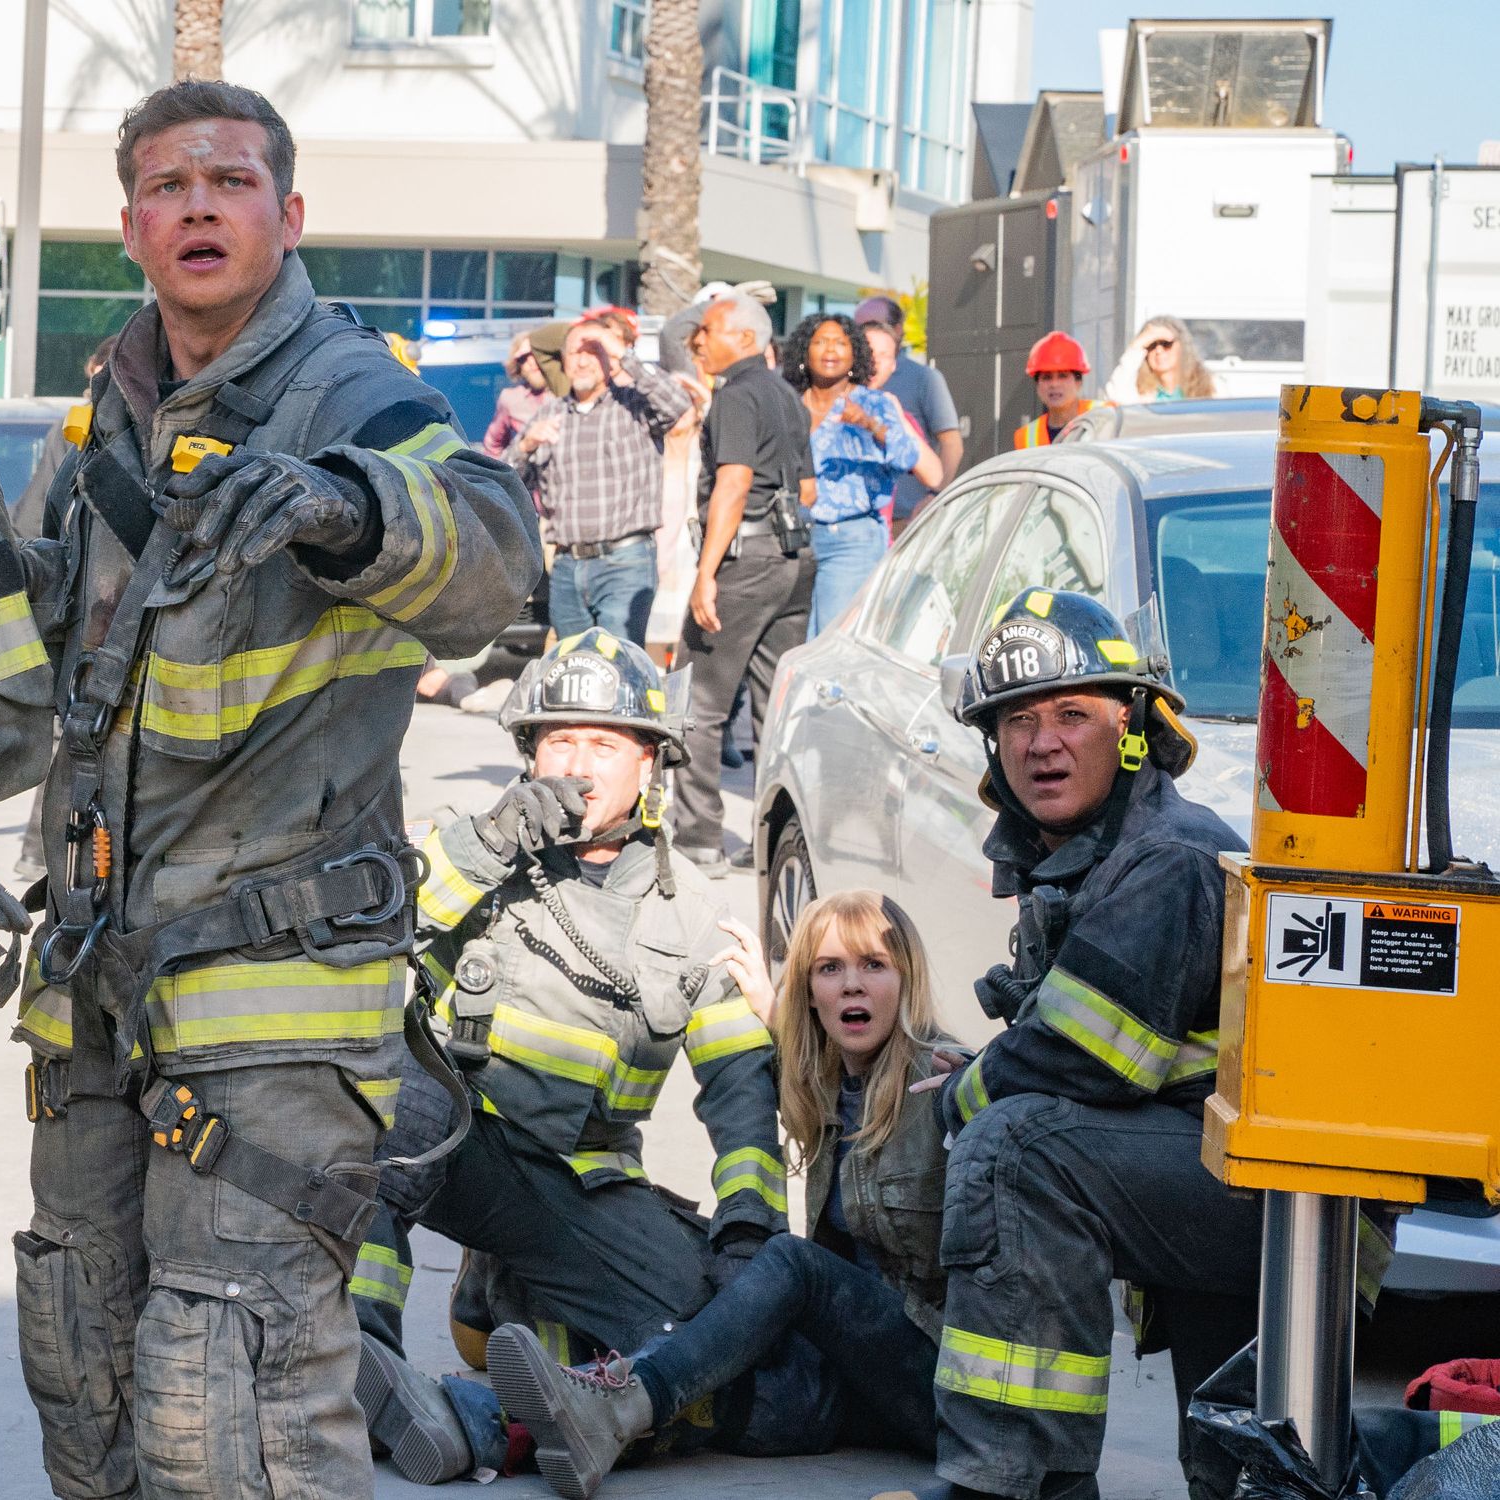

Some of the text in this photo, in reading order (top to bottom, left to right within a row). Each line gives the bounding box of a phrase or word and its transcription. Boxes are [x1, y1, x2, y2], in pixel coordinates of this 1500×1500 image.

[1474, 206, 1500, 229] SE
[1446, 305, 1471, 327] MAX
[1446, 330, 1477, 352] TARE
[984, 625, 1056, 661] LOS ANGELES
[547, 656, 614, 684] LOS ANGELES
[997, 646, 1040, 683] 118
[561, 673, 596, 703] 118
[1392, 907, 1451, 921] WARNING
[1371, 929, 1389, 937] Keep
[1404, 940, 1426, 948] beams
[1369, 964, 1422, 974] being operated.
[1385, 957, 1419, 965] outriggers
